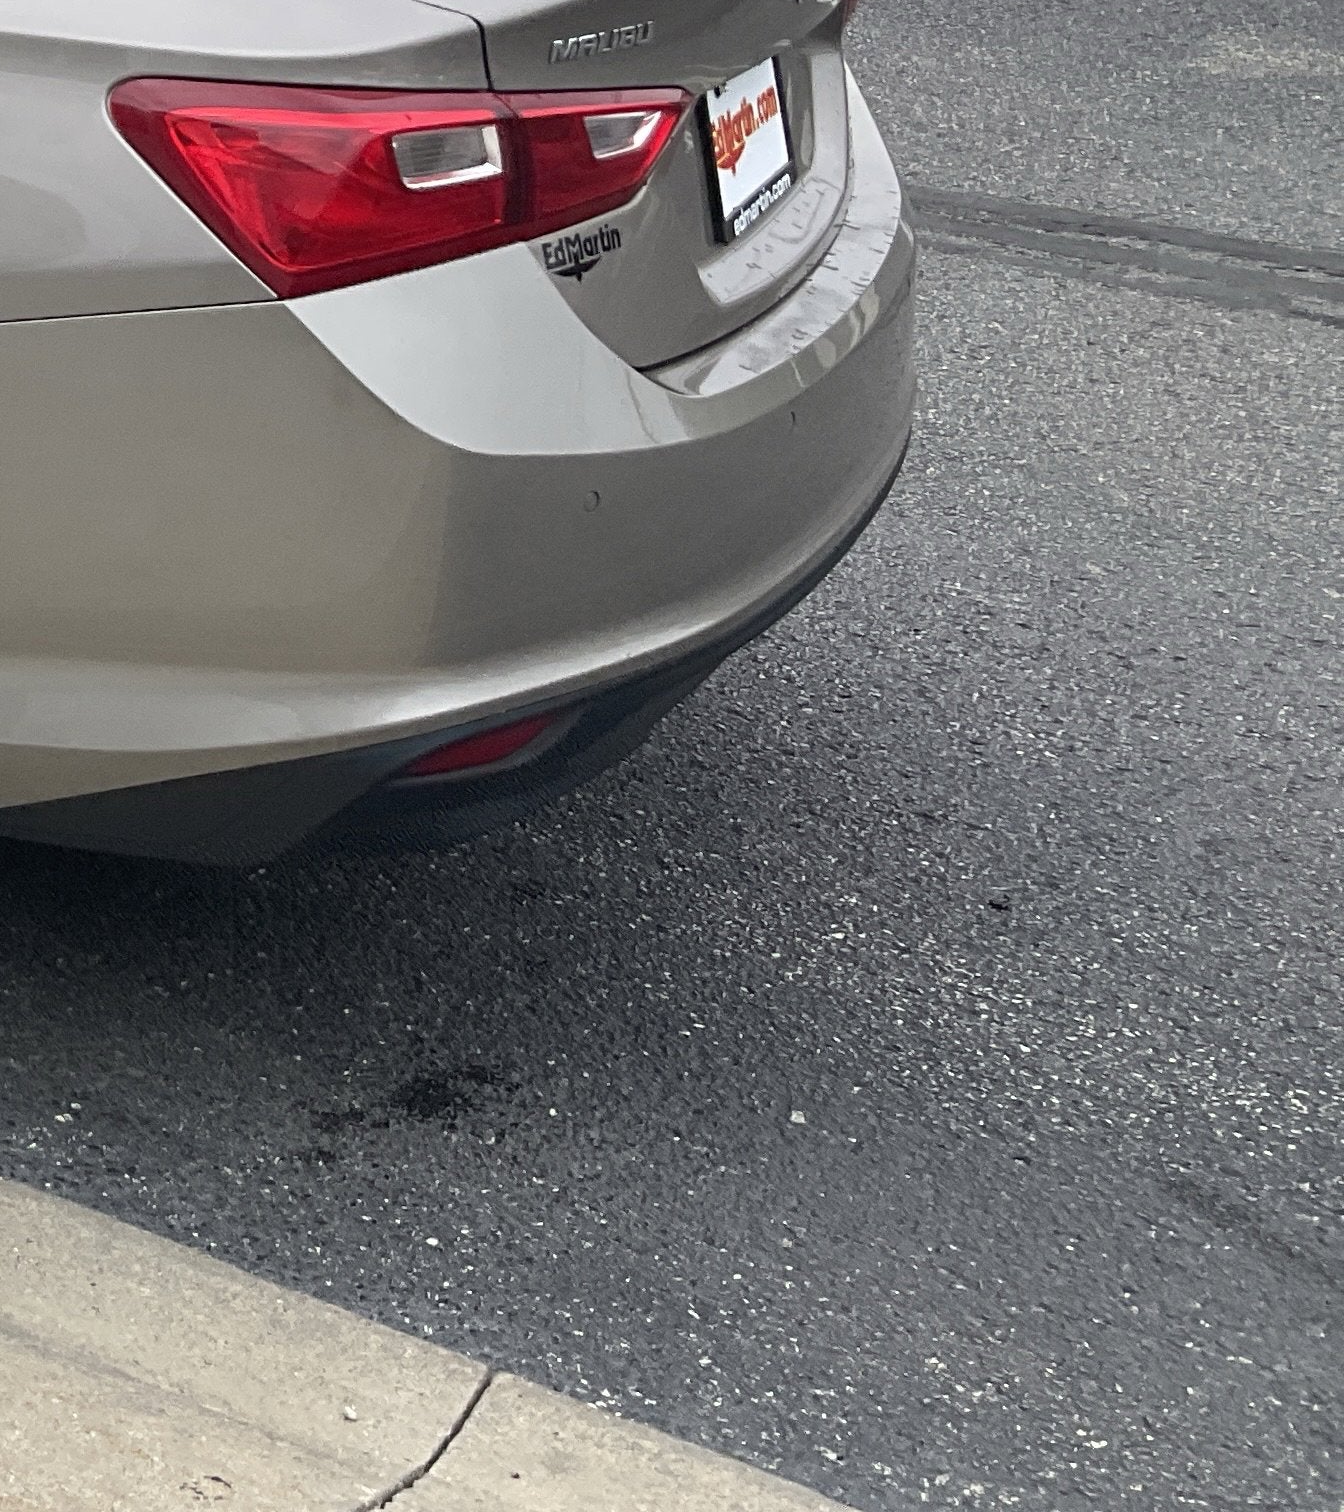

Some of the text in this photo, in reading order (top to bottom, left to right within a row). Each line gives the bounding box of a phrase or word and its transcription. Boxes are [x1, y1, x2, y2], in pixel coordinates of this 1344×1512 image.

[548, 20, 655, 65] MALIBU
[733, 173, 791, 236] edmartin.com
[541, 223, 622, 270] EdMartin
